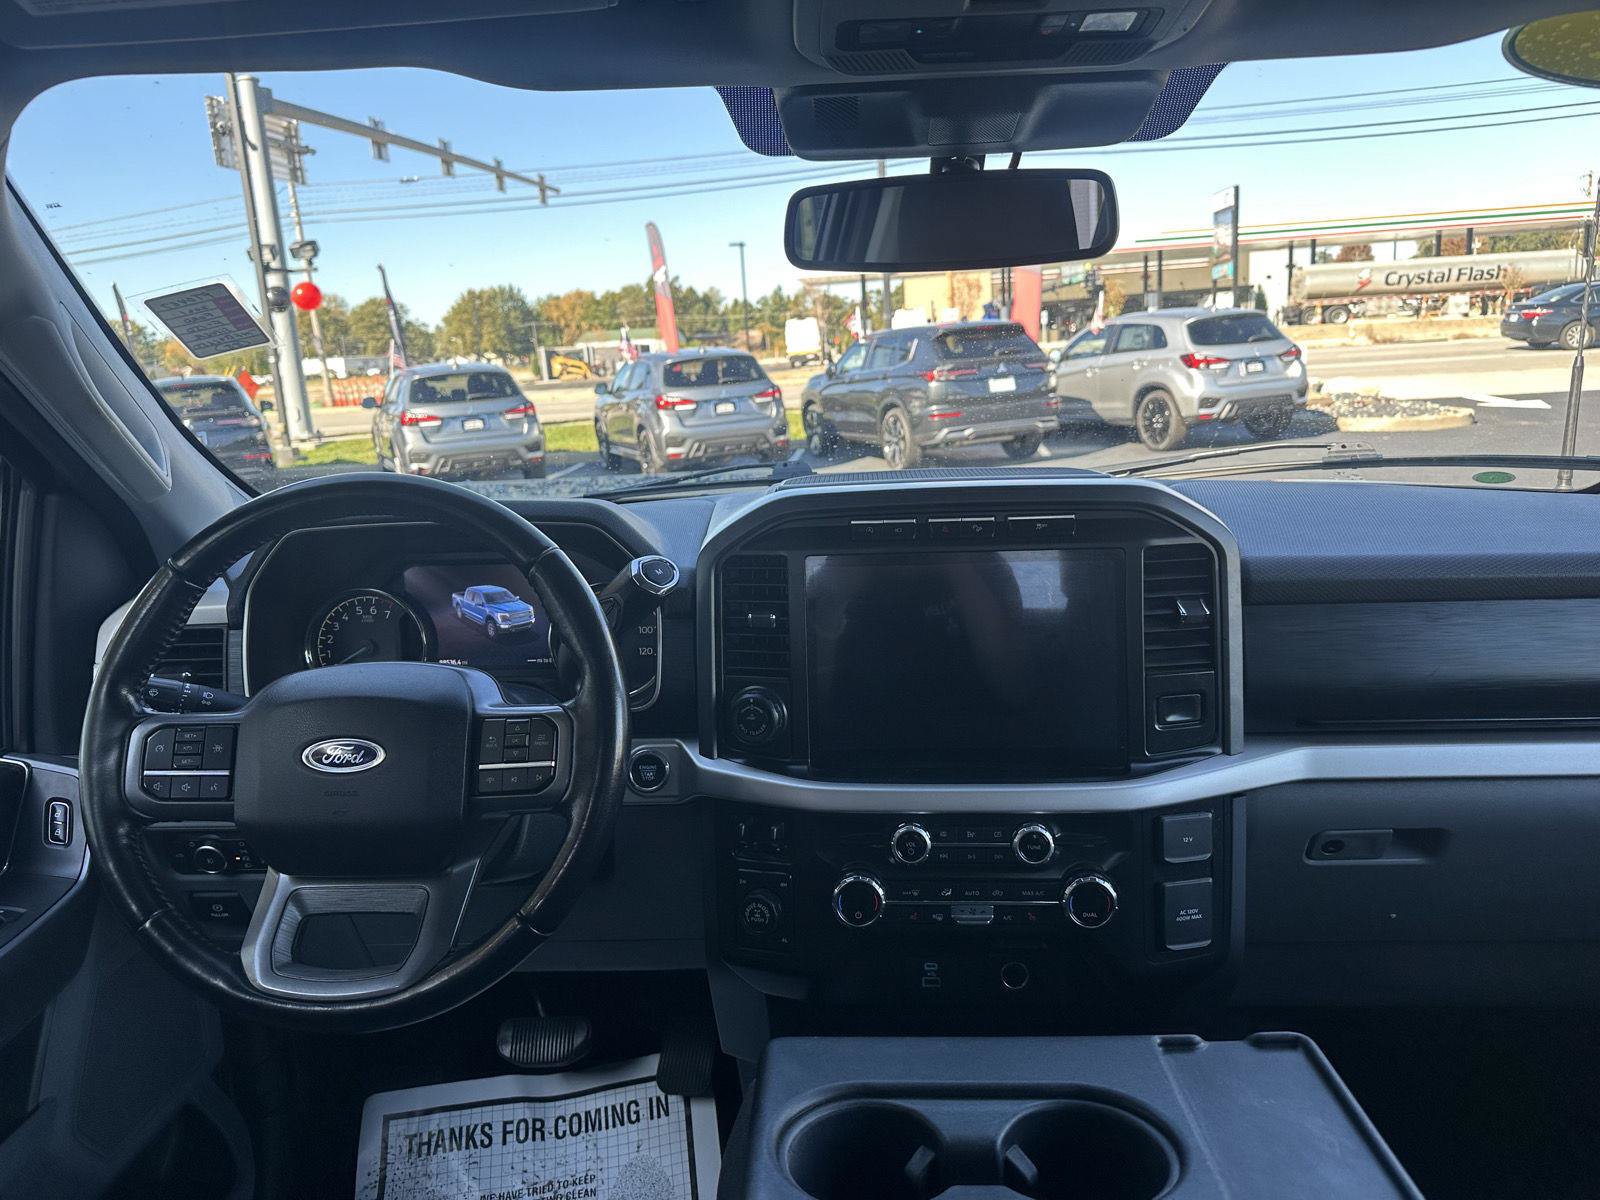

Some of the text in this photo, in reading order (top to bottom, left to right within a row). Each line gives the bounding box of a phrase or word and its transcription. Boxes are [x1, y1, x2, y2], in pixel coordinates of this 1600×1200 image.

[1385, 268, 1452, 289] Crystal
[356, 606, 363, 615] 5
[370, 606, 377, 615] 6
[384, 610, 391, 619] 7
[342, 612, 349, 621] 4
[333, 622, 340, 631] 3
[638, 626, 653, 634] 100
[326, 635, 334, 644] 2
[638, 647, 653, 655] 120
[321, 744, 365, 765] Ford
[404, 1095, 670, 1163] THANKS FOR COMING IN
[498, 1188, 524, 1200] HAVE
[526, 1183, 554, 1197] TRIED
[557, 1179, 570, 1190] TO
[572, 1174, 596, 1187] KEEP
[566, 1187, 597, 1200] CLEAN
